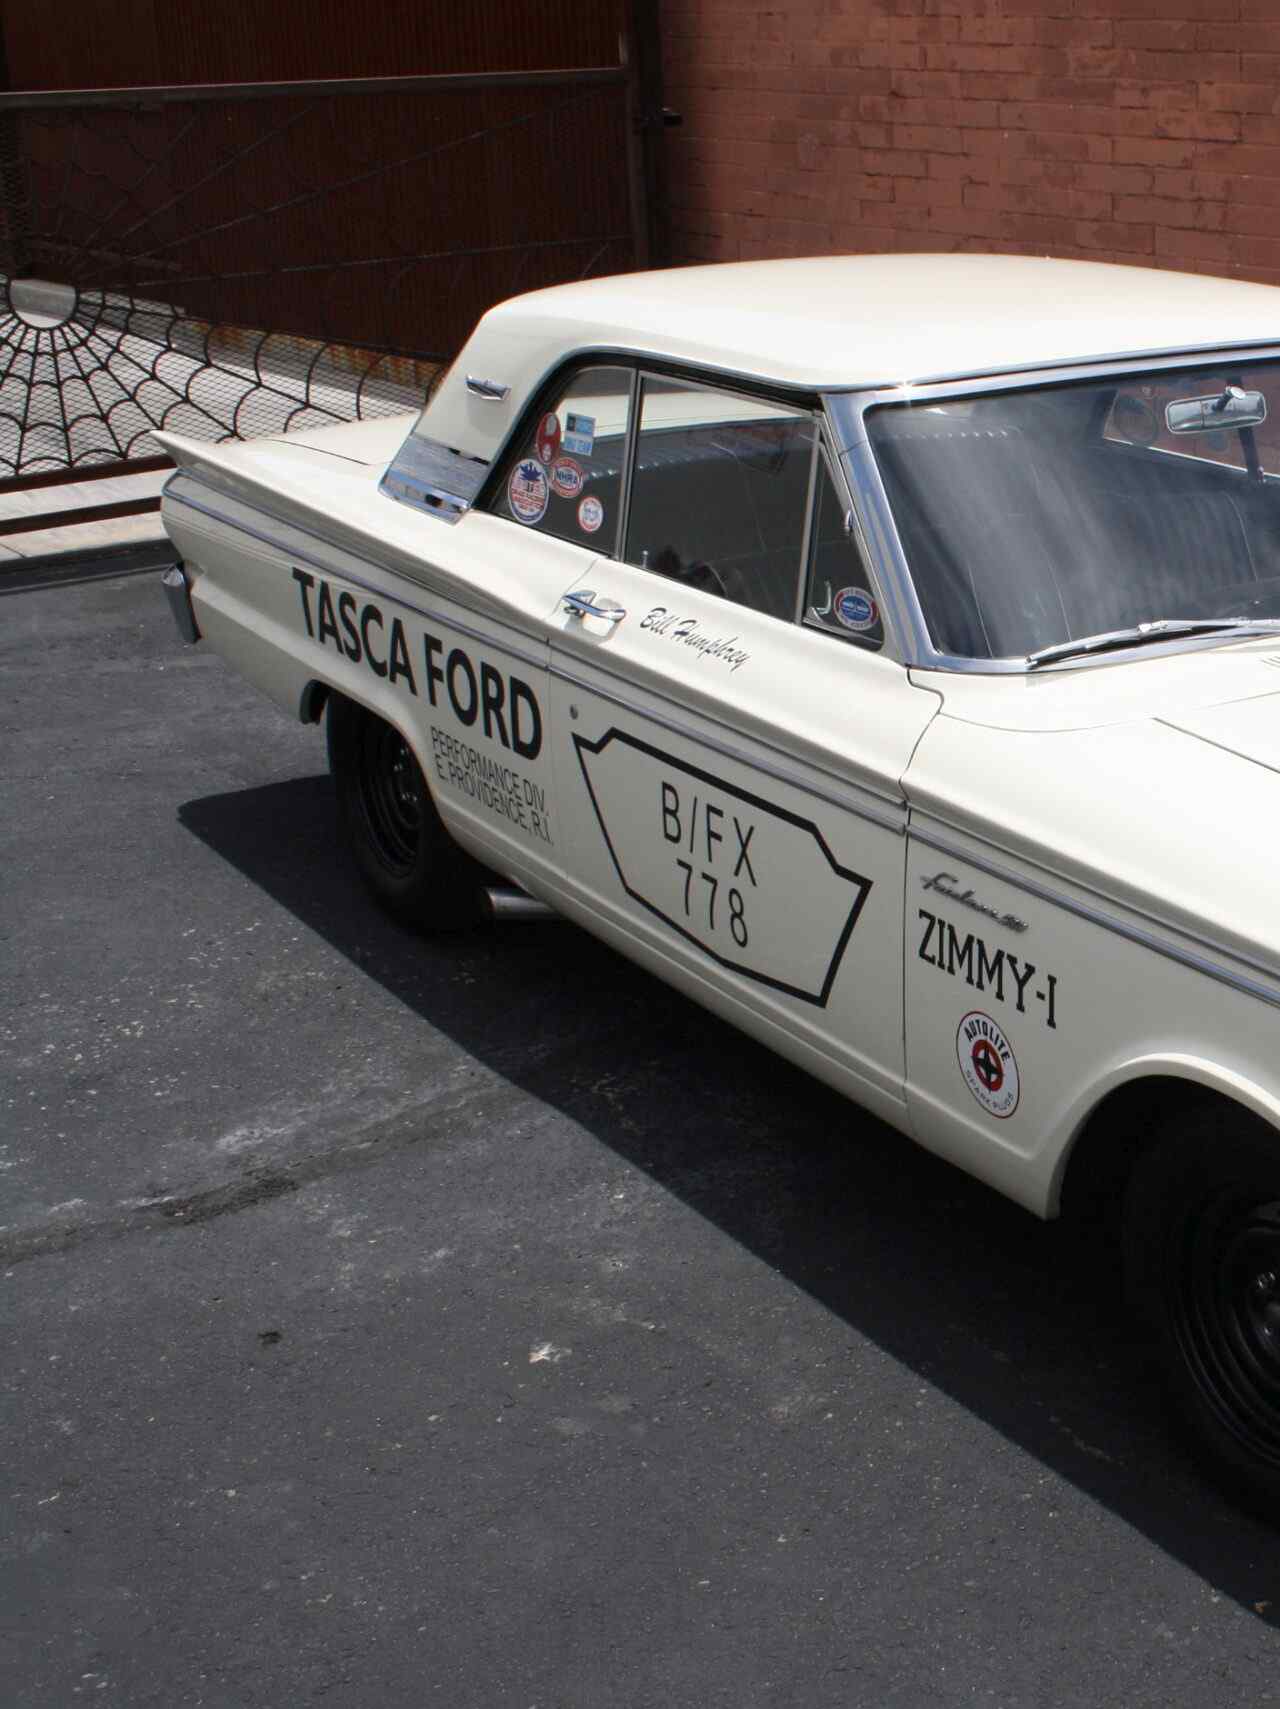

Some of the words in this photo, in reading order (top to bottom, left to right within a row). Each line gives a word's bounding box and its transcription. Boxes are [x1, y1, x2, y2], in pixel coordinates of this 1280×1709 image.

[292, 566, 418, 697] TASCA
[424, 632, 543, 760] FORD
[640, 607, 681, 636] Bill
[431, 725, 523, 803] PERFORMANCE
[662, 780, 757, 887] B/FX
[676, 857, 748, 948] 778
[964, 1018, 1011, 1064] AUTOLITE
